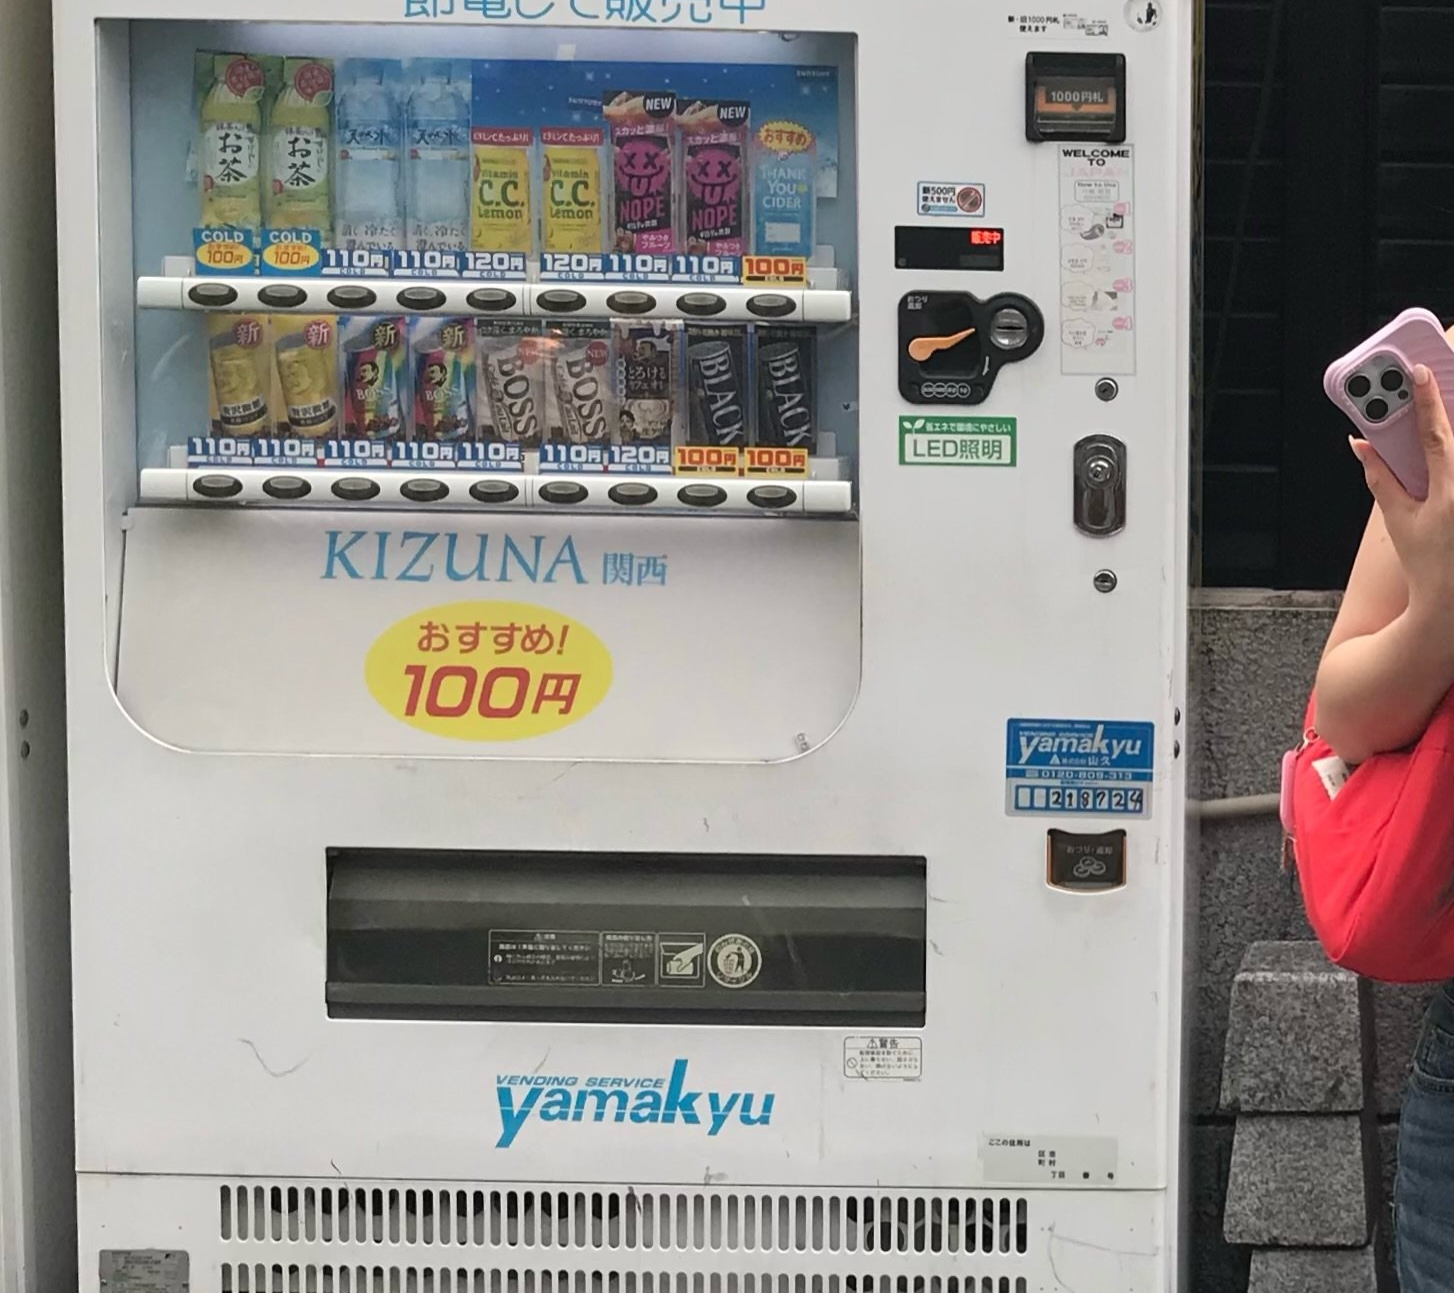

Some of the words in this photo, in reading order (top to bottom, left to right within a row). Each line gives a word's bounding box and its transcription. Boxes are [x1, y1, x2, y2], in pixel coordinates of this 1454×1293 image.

[645, 97, 672, 111] NEW
[1051, 91, 1104, 102] 1000円札
[719, 106, 746, 120] NEW
[763, 128, 808, 145] おすすめ
[215, 132, 248, 183] お茶
[284, 136, 316, 187] お茶
[1062, 149, 1131, 158] WELCOME
[1087, 158, 1106, 167] TO
[478, 179, 526, 207] C.C.
[550, 179, 596, 207] C.C.
[767, 180, 797, 195] YOU
[620, 195, 665, 223] NOPE
[762, 195, 803, 209] CIDER
[477, 207, 523, 220] Lemon
[549, 207, 593, 220] Lemon
[692, 204, 737, 230] NOPE
[201, 231, 245, 243] COLD
[269, 231, 313, 243] COLD
[970, 230, 1002, 245] 販売中
[207, 250, 244, 264] 100円
[273, 251, 311, 265] 100円
[327, 249, 384, 268] 110円
[399, 250, 455, 269] 110円
[465, 252, 524, 271] 120円
[544, 254, 602, 272] 120円
[609, 255, 667, 272] 110円
[676, 257, 733, 274] 110円
[745, 257, 804, 276] 100円
[236, 321, 260, 345] 新
[307, 323, 331, 348] 新
[374, 324, 396, 347] 新
[442, 325, 464, 348] 新
[586, 349, 607, 358] NEW
[627, 366, 667, 381] とろける
[355, 386, 391, 400] BOSS
[425, 387, 460, 401] BOSS
[497, 356, 538, 436] BOSS
[566, 358, 607, 437] BOSS
[700, 354, 744, 446] BLACK
[768, 355, 811, 447] BLACK
[193, 437, 250, 456] 110円
[258, 438, 314, 457] 110円
[328, 439, 385, 458] 110円
[396, 441, 453, 460] 110円
[462, 442, 519, 461] 110円
[544, 444, 601, 463] 110円
[610, 445, 669, 464] 120円
[912, 438, 1003, 460] LED照明
[677, 448, 737, 466] 100円
[746, 449, 805, 467] 100円
[319, 529, 590, 585] KIZUNA
[601, 552, 669, 587] 関西
[417, 620, 570, 656] おすすめ!
[403, 663, 582, 719] 100円
[1018, 723, 1142, 765] yamakyu
[495, 1075, 578, 1087] VENDING
[585, 1077, 666, 1089] SERVICE
[494, 1058, 776, 1148] yamakyu
